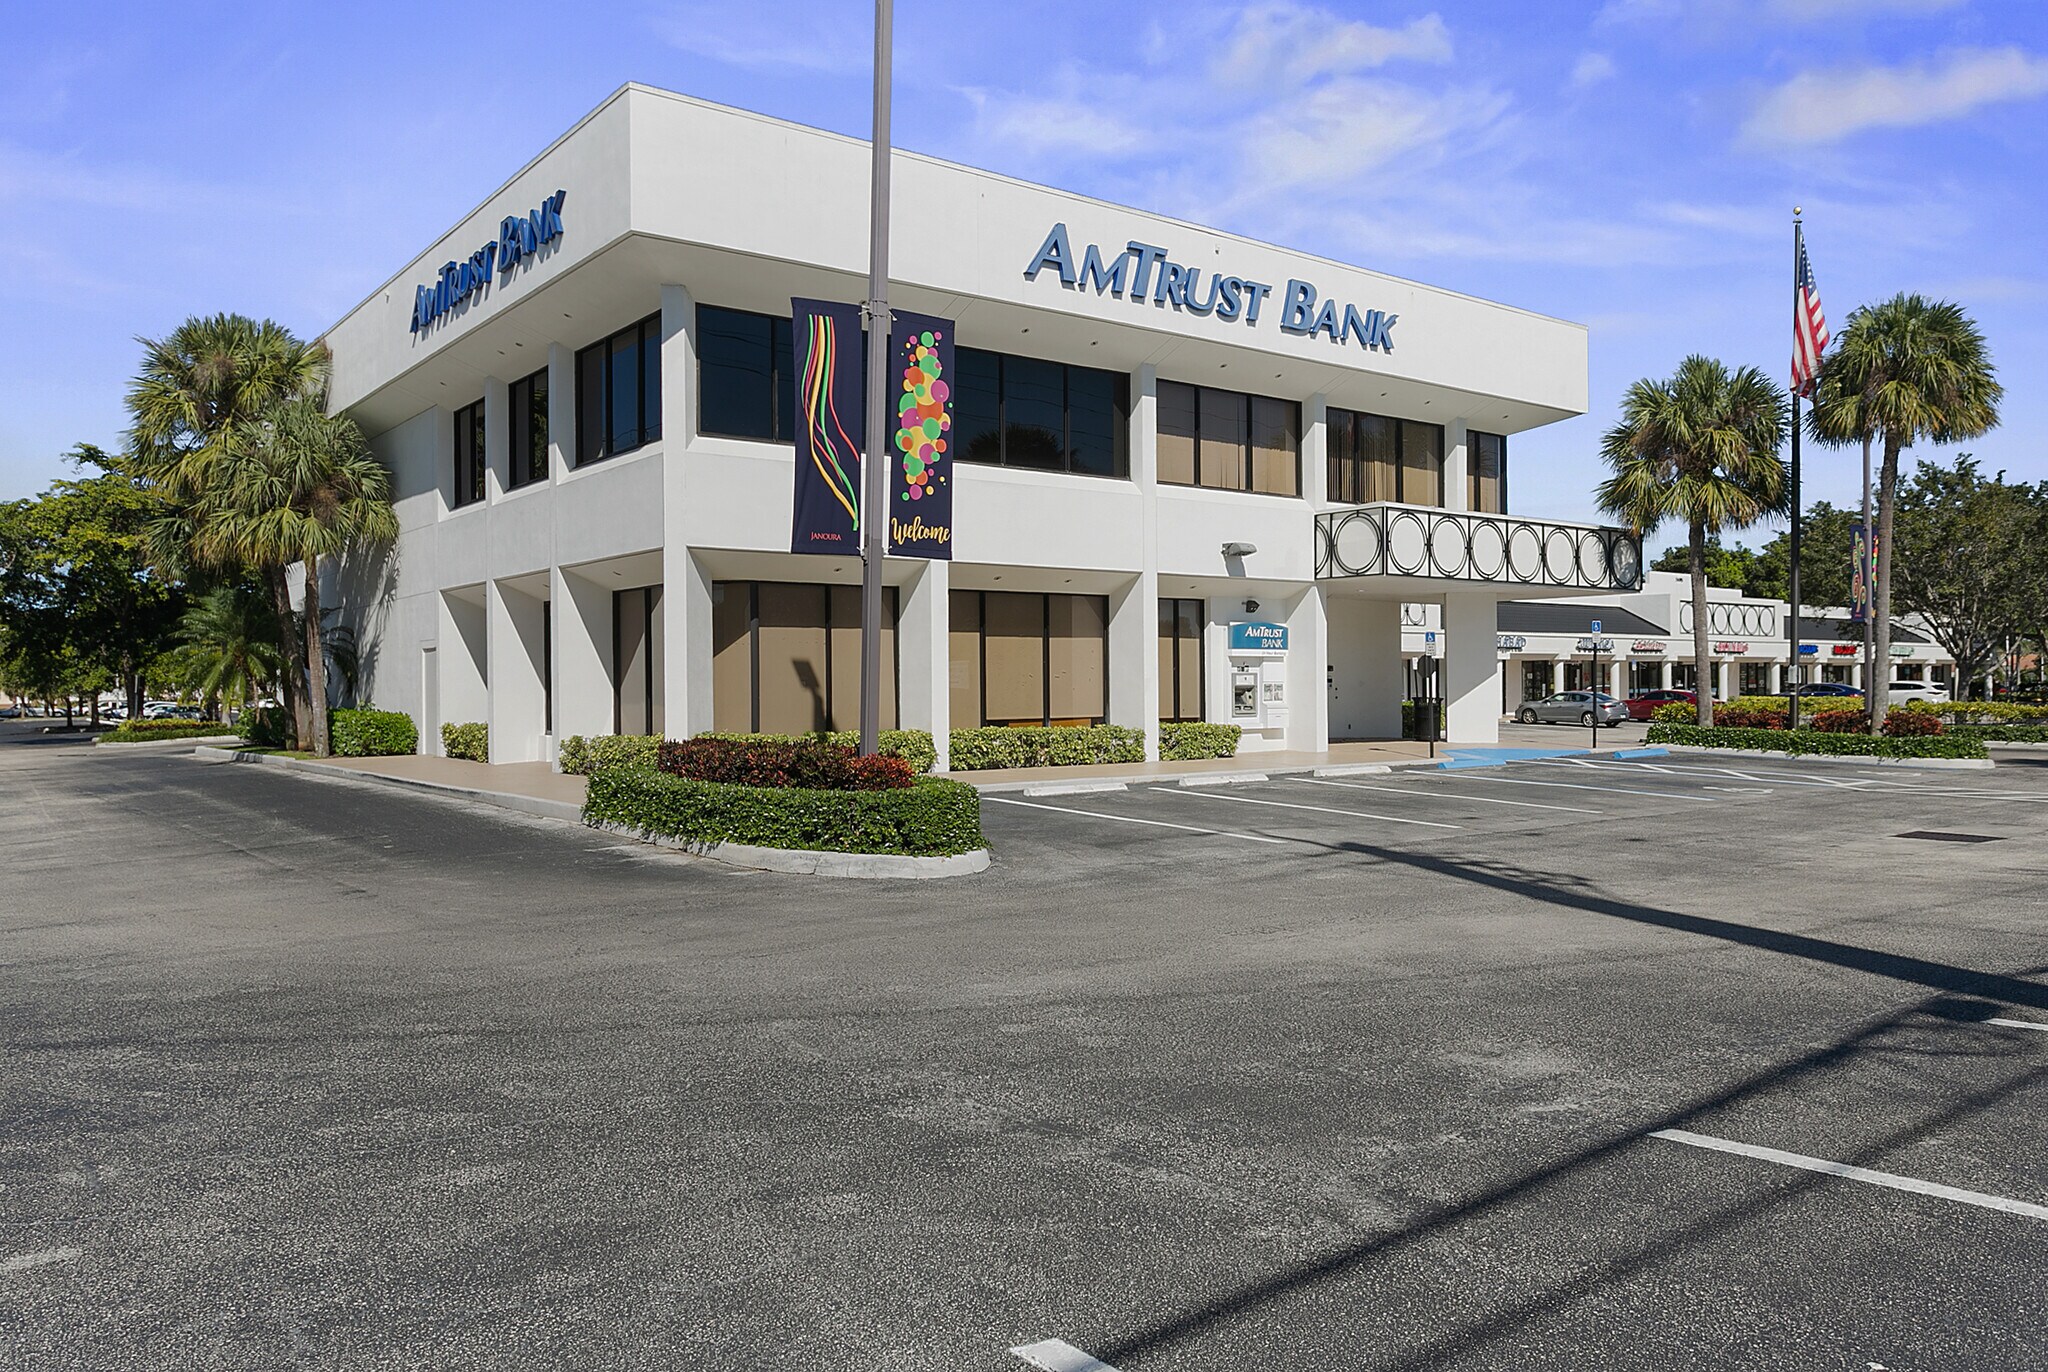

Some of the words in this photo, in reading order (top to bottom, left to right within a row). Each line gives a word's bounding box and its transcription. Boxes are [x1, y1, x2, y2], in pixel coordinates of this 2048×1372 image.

[497, 189, 567, 273] BANK
[1280, 278, 1399, 351] BANK
[810, 531, 842, 541] JANOURA
[891, 516, 950, 545] Welcome
[1261, 639, 1283, 648] BANK
